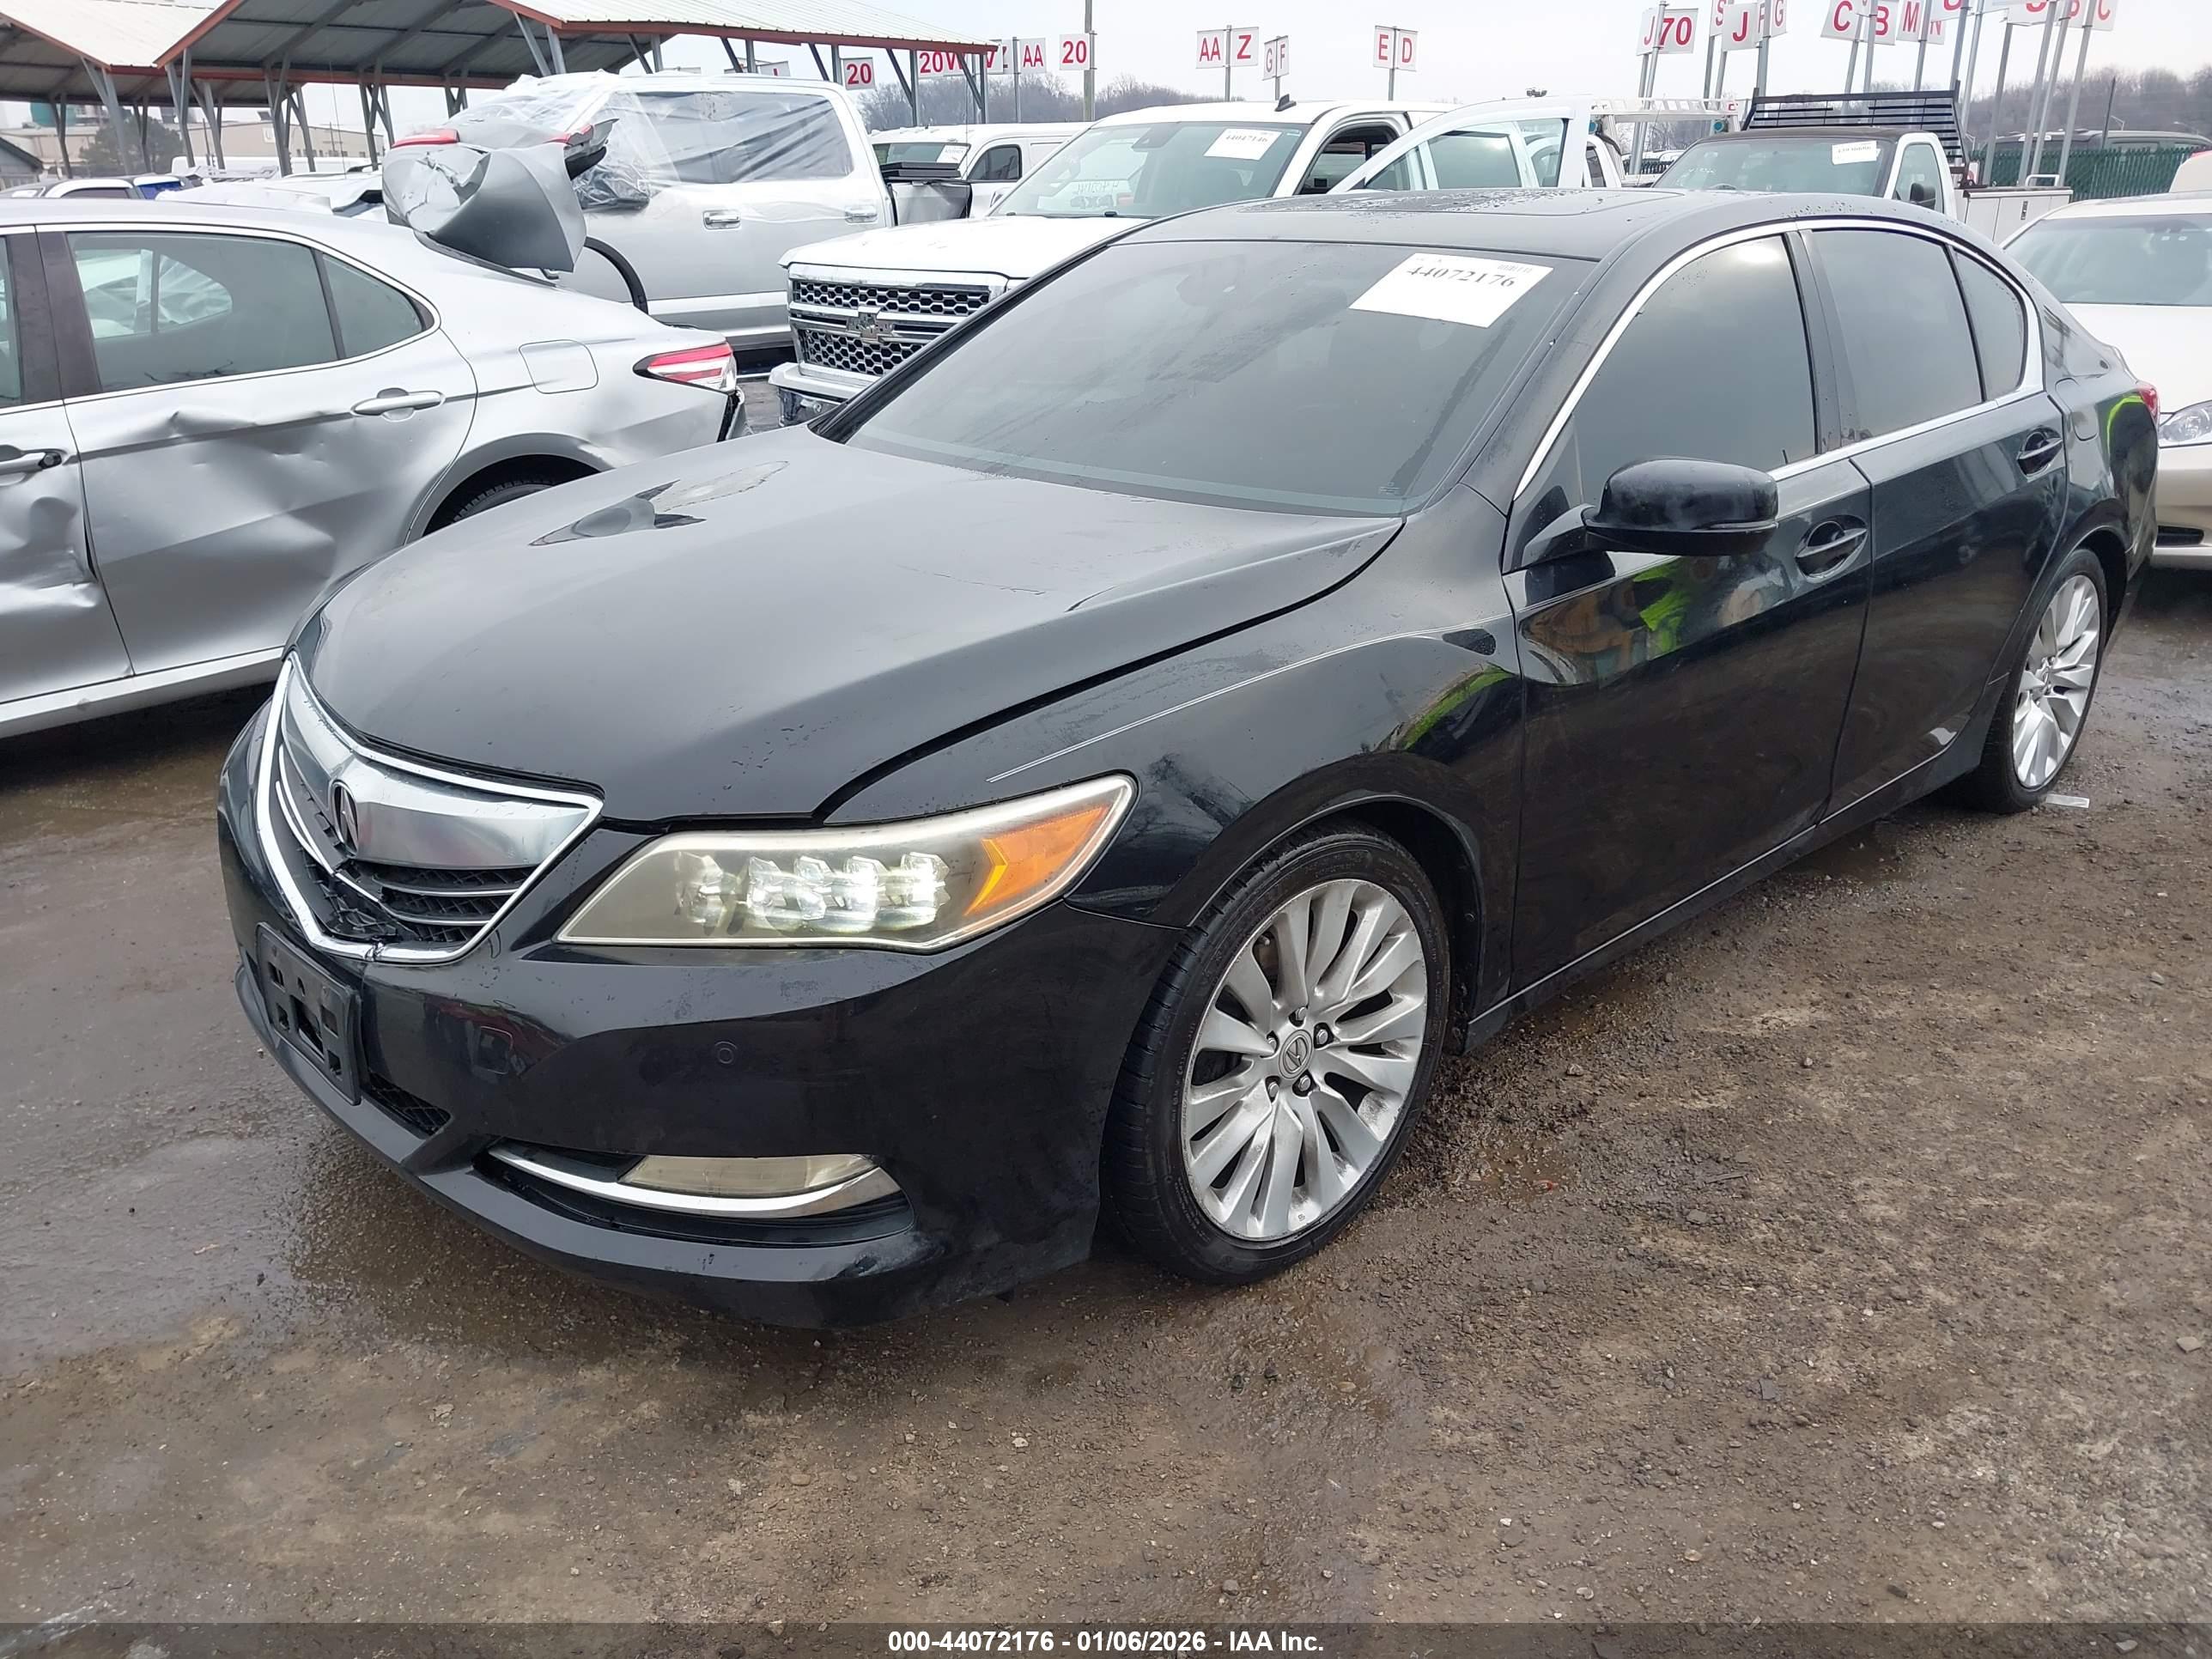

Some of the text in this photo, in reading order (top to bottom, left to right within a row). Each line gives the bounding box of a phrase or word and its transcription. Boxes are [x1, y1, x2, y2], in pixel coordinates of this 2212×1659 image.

[1732, 11, 1748, 41] J
[1833, 1, 1853, 31] C
[1903, 2, 1919, 33] M
[1659, 16, 1692, 46] 70
[1023, 45, 1043, 67] AA
[1061, 40, 1088, 64] 20
[1199, 37, 1221, 62] AA
[1237, 34, 1252, 59] Z
[1279, 44, 1285, 69] F
[1378, 33, 1389, 60] E
[1401, 37, 1413, 63] D
[846, 63, 872, 84] 20
[920, 51, 944, 74] 20
[1407, 266, 1516, 288] 44072176
